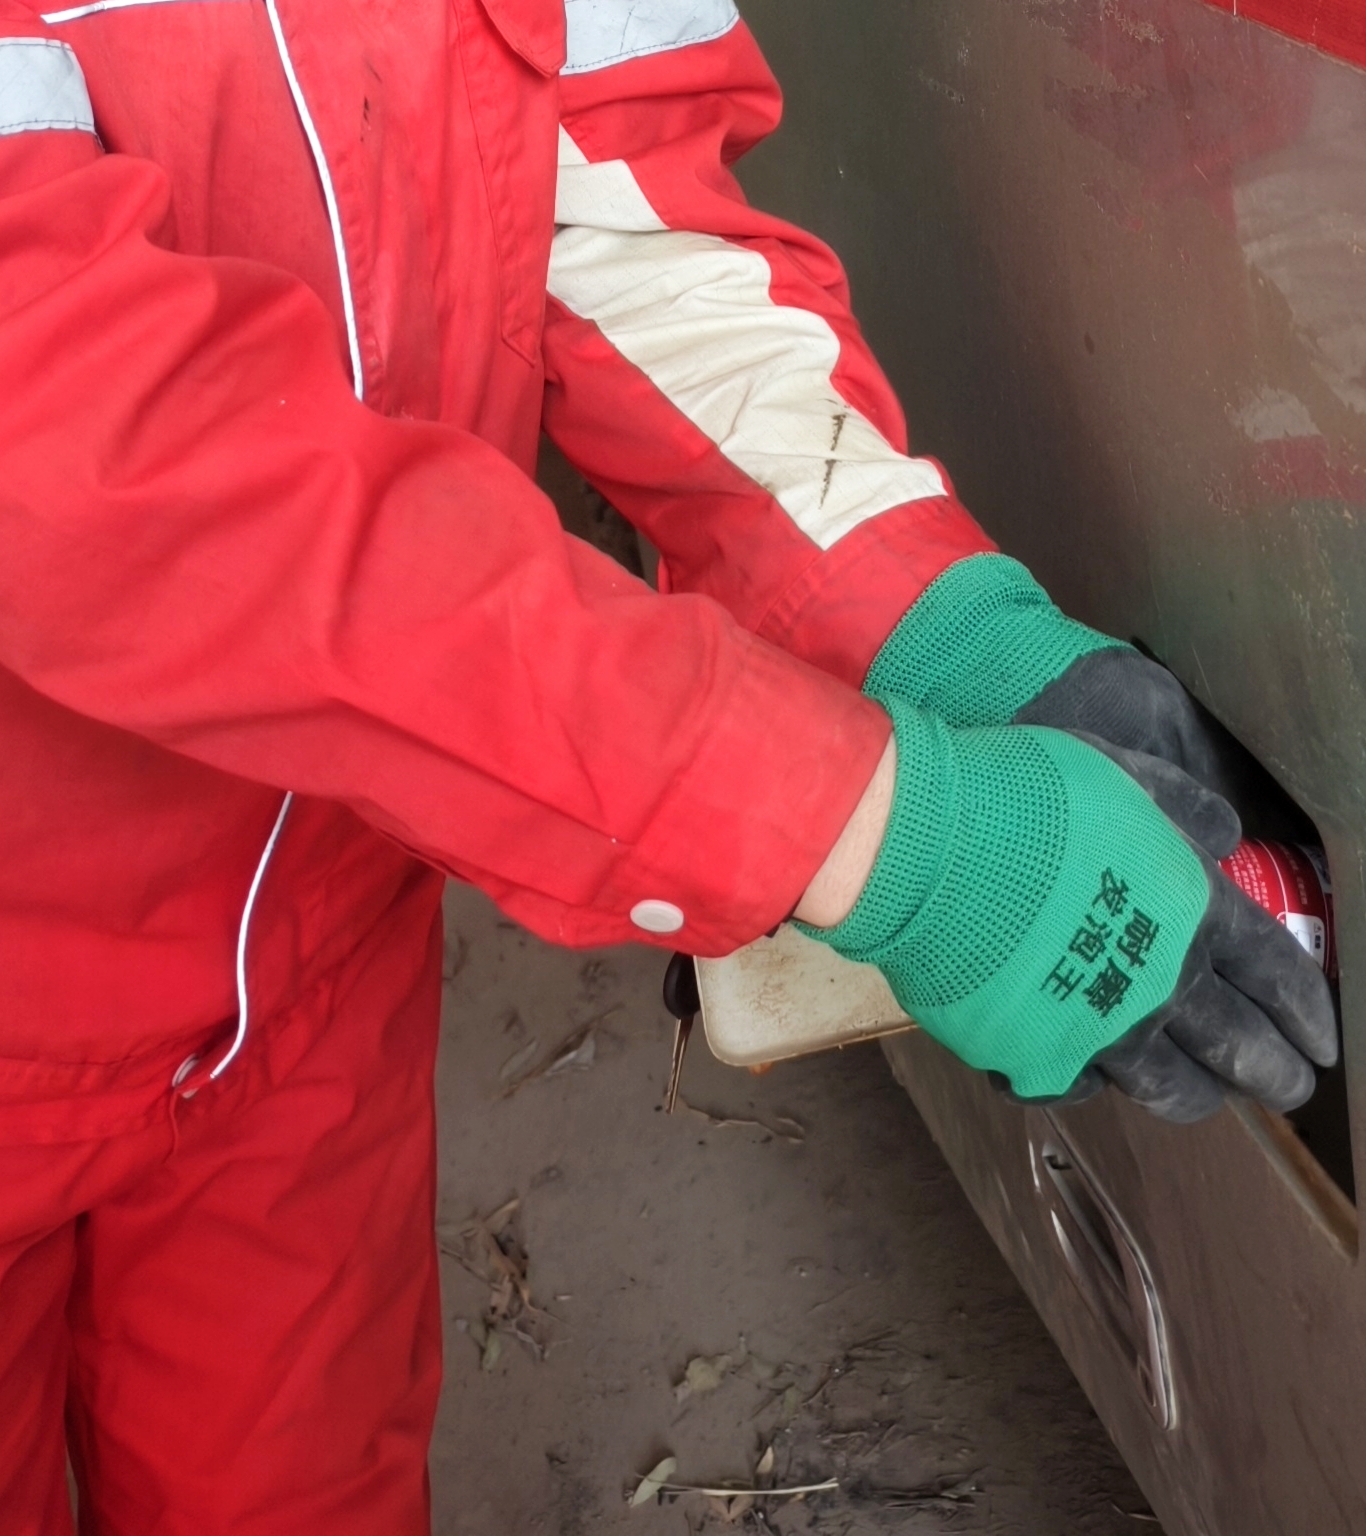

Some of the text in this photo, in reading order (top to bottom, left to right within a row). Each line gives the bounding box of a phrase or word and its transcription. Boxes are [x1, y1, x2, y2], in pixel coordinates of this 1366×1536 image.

[1039, 866, 1129, 1001] 发泡王
[1083, 906, 1160, 1017] 耐磨
